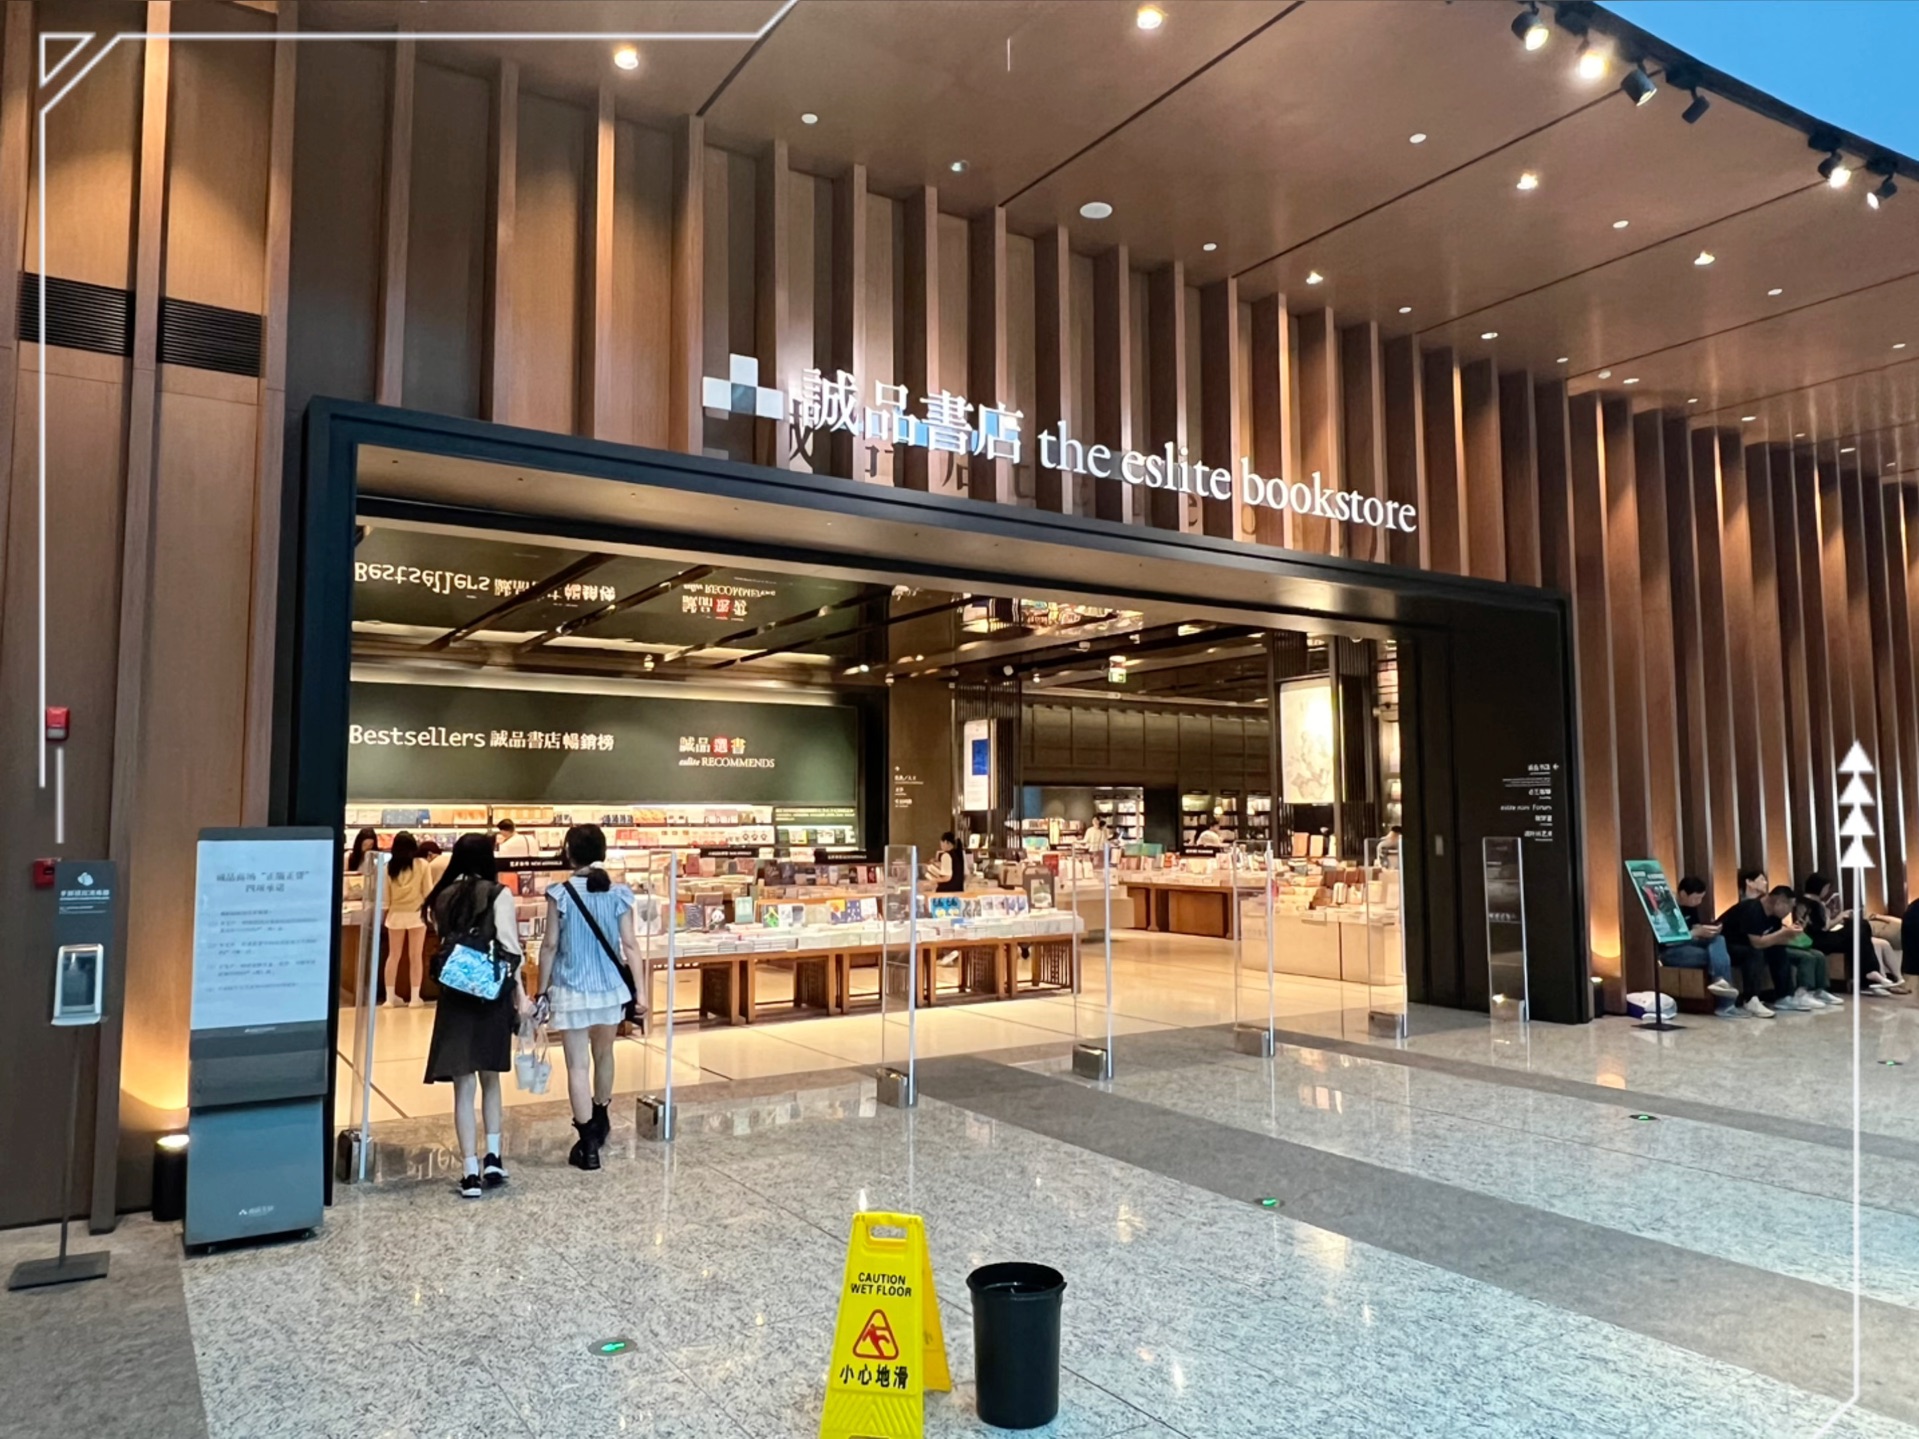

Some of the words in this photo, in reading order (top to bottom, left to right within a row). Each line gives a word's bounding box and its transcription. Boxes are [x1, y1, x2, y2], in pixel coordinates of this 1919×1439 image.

[788, 368, 1024, 464] 誠品書店
[1038, 420, 1111, 478] the
[1121, 441, 1232, 501] eslite
[1240, 457, 1417, 533] bookstore
[349, 725, 486, 747] Bestsellers
[702, 757, 776, 768] RECOMMENDS
[858, 1272, 906, 1286] CAUTION
[851, 1283, 873, 1295] WET
[876, 1285, 912, 1297] FLOOR
[840, 1364, 908, 1389] 小心地滑
